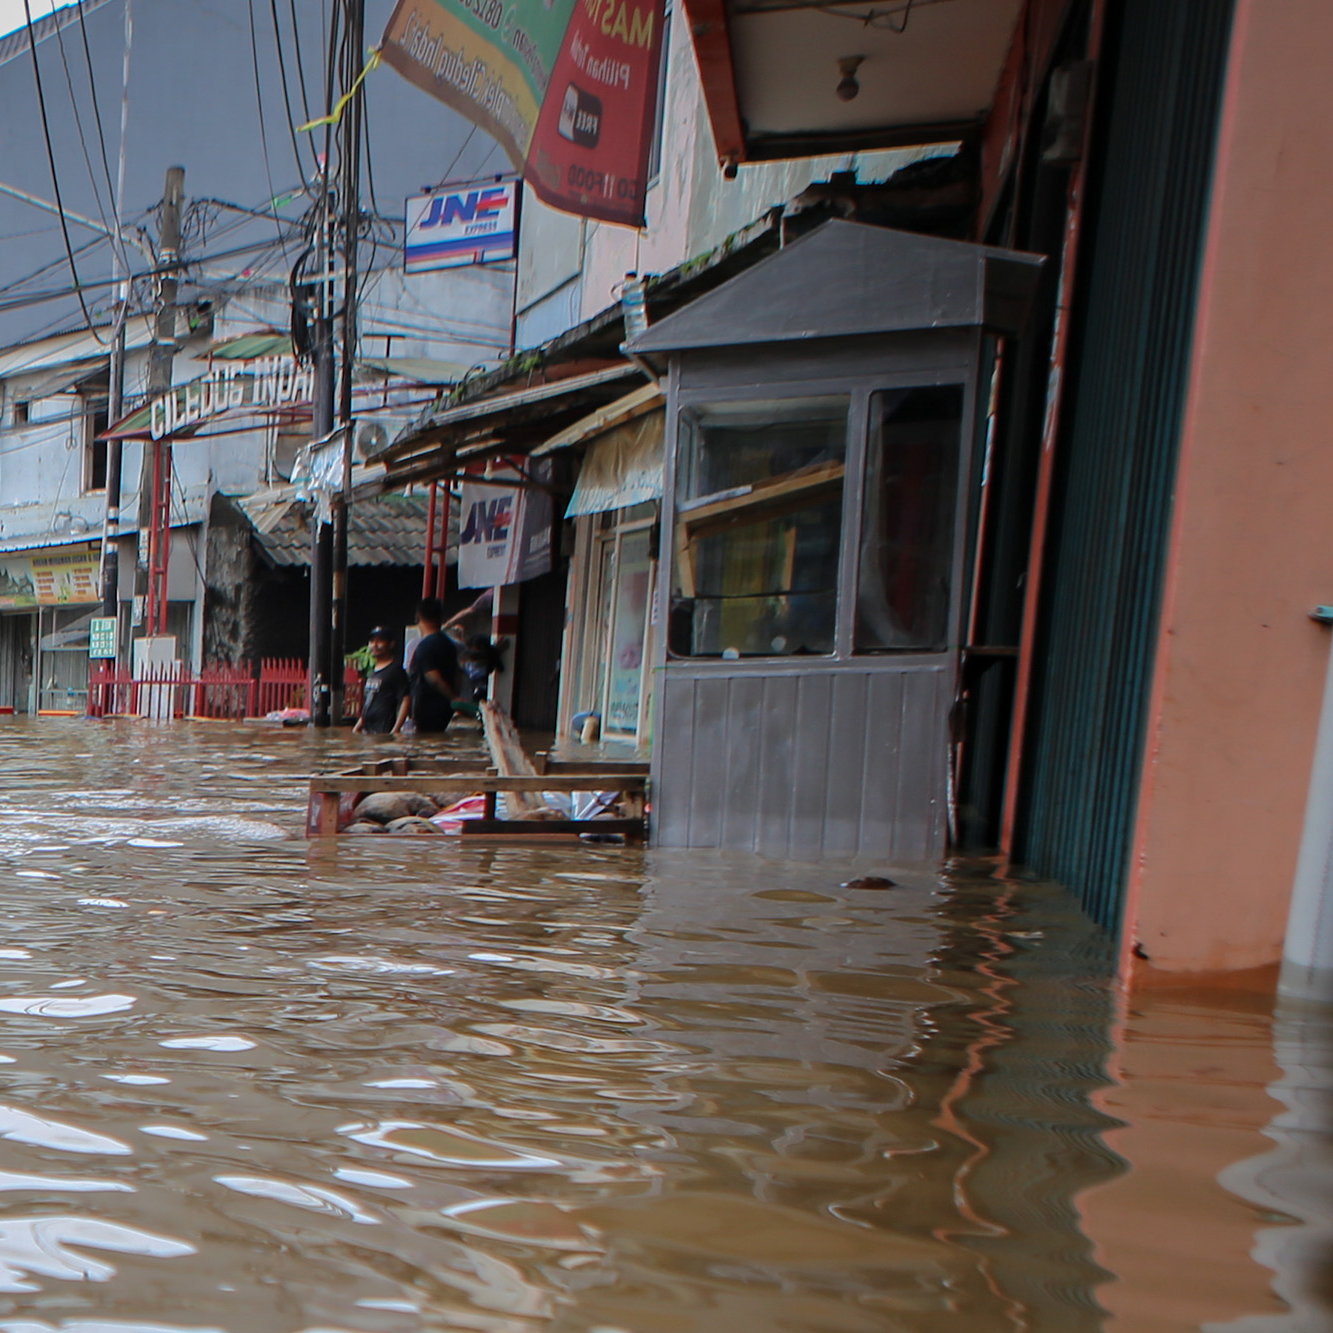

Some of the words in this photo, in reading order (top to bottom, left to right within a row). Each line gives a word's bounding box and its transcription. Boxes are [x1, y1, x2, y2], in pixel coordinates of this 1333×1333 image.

[419, 187, 509, 229] JNE
[150, 361, 247, 441] CILEDUG
[461, 496, 513, 545] JNE
